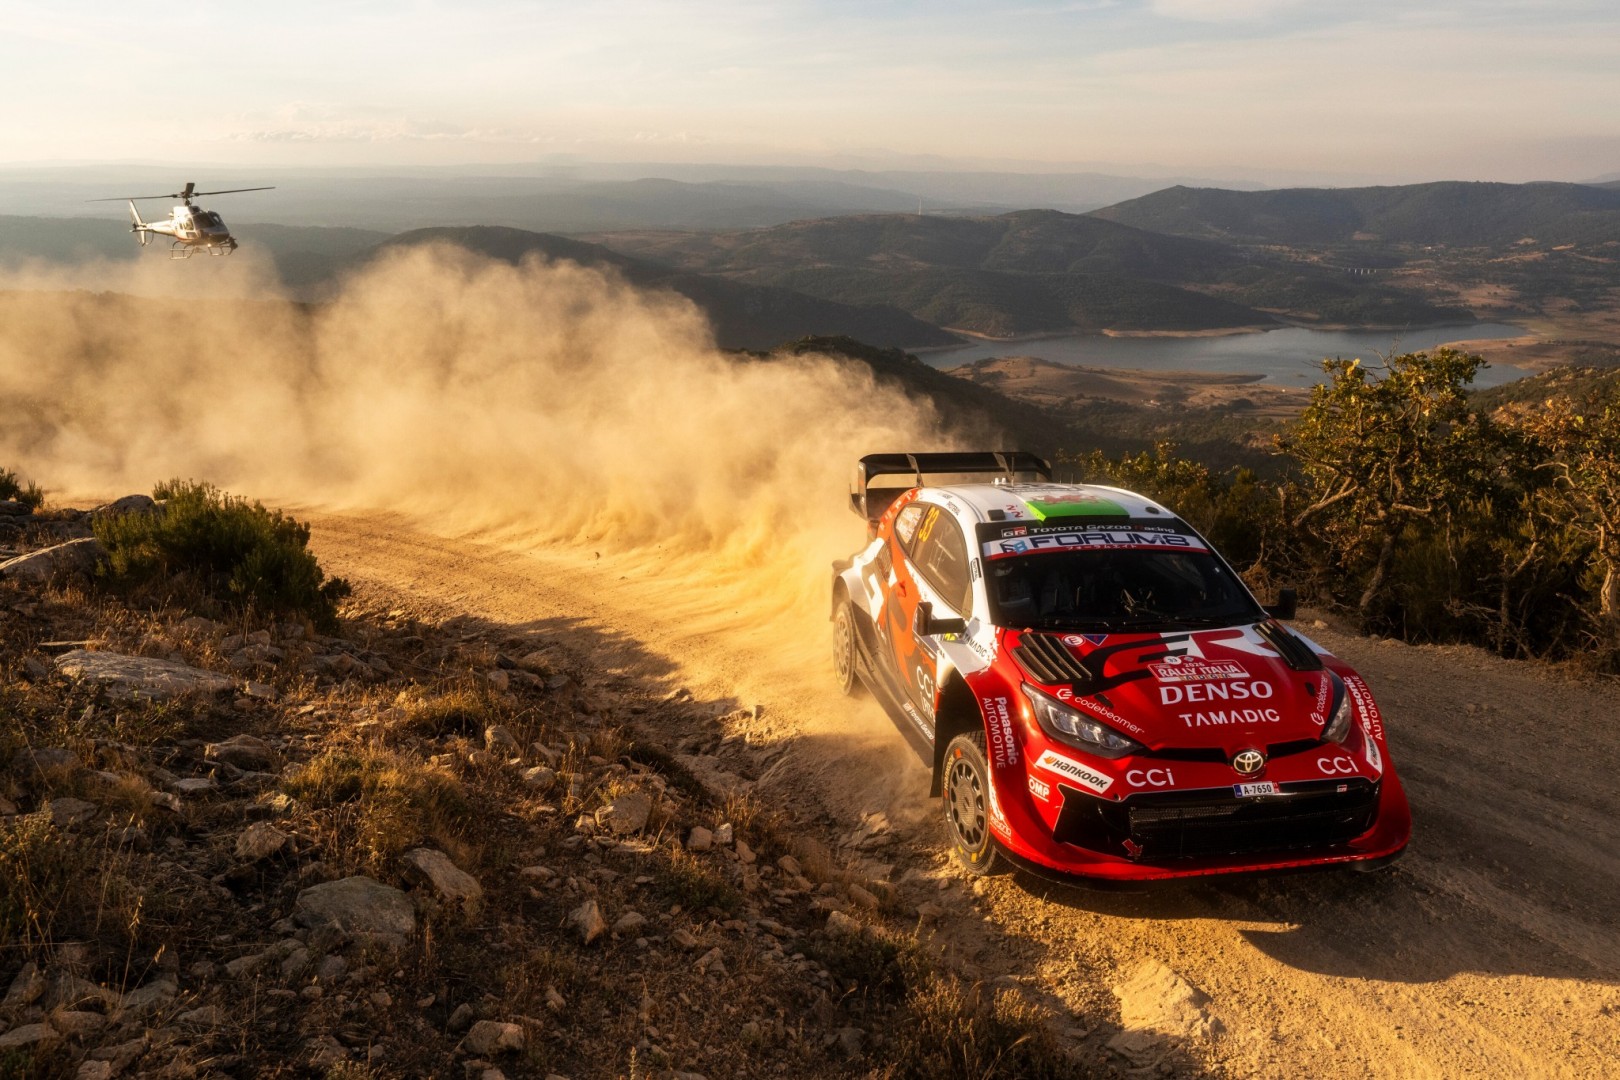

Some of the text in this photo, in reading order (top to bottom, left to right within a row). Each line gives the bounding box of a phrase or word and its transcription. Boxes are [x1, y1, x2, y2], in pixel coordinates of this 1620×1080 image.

[918, 506, 940, 543] 33
[1030, 525, 1084, 534] TOYOTA
[1086, 523, 1132, 532] GAZOO
[1028, 533, 1191, 549] FORUM8
[1157, 664, 1242, 678] RALLY ITALIA
[1159, 681, 1273, 705] DENSO
[1074, 696, 1143, 734] codebeamer
[1179, 709, 1280, 727] TAMADIC
[1351, 675, 1383, 740] AUTOMOTIVE
[982, 697, 1006, 769] AUTOMOTIVE
[995, 696, 1019, 766] Panasonic
[1028, 777, 1050, 797] OMP
[1243, 784, 1272, 795] A-7650
